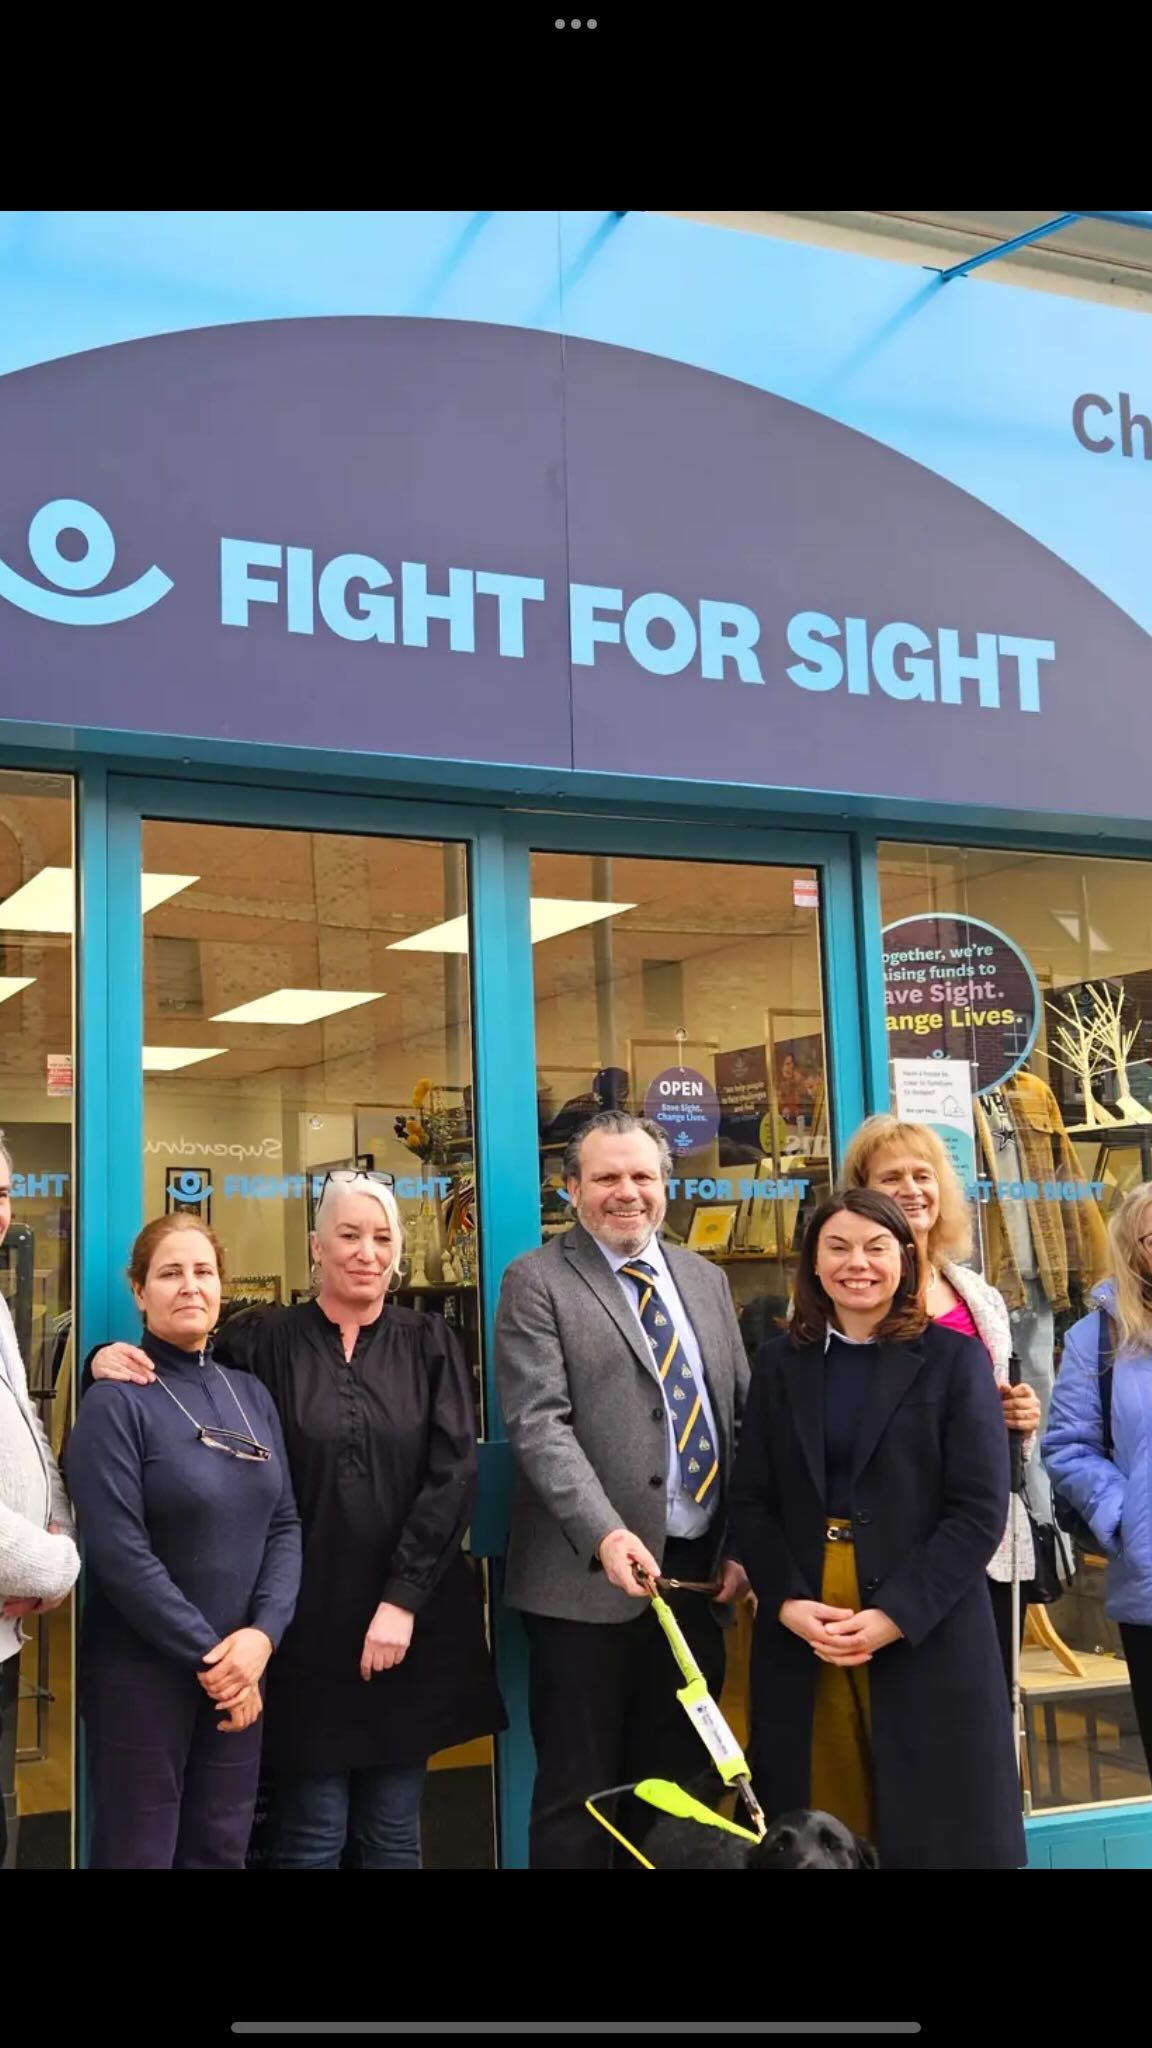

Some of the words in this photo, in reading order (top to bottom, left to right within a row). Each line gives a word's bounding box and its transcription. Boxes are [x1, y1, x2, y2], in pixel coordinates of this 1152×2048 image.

[221, 538, 545, 658] FIGHT
[570, 584, 765, 685] FOR
[787, 612, 1055, 713] SIGHT
[881, 948, 946, 966] ogether,
[884, 967, 926, 983] ising
[929, 964, 975, 979] funds
[978, 964, 996, 975] to
[884, 988, 923, 1004] ave
[930, 980, 1005, 1006] Sight.
[885, 1012, 943, 1035] ange
[951, 1006, 1023, 1027] Lives.
[660, 1081, 703, 1096] OPEN
[10, 1173, 69, 1198] GHT
[224, 1174, 307, 1199] FIGHT
[396, 1176, 452, 1199] GHT
[685, 1178, 732, 1200] FOR
[738, 1178, 809, 1200] SIGHT
[997, 1181, 1038, 1200] FOR
[1043, 1181, 1105, 1201] SIGHT
